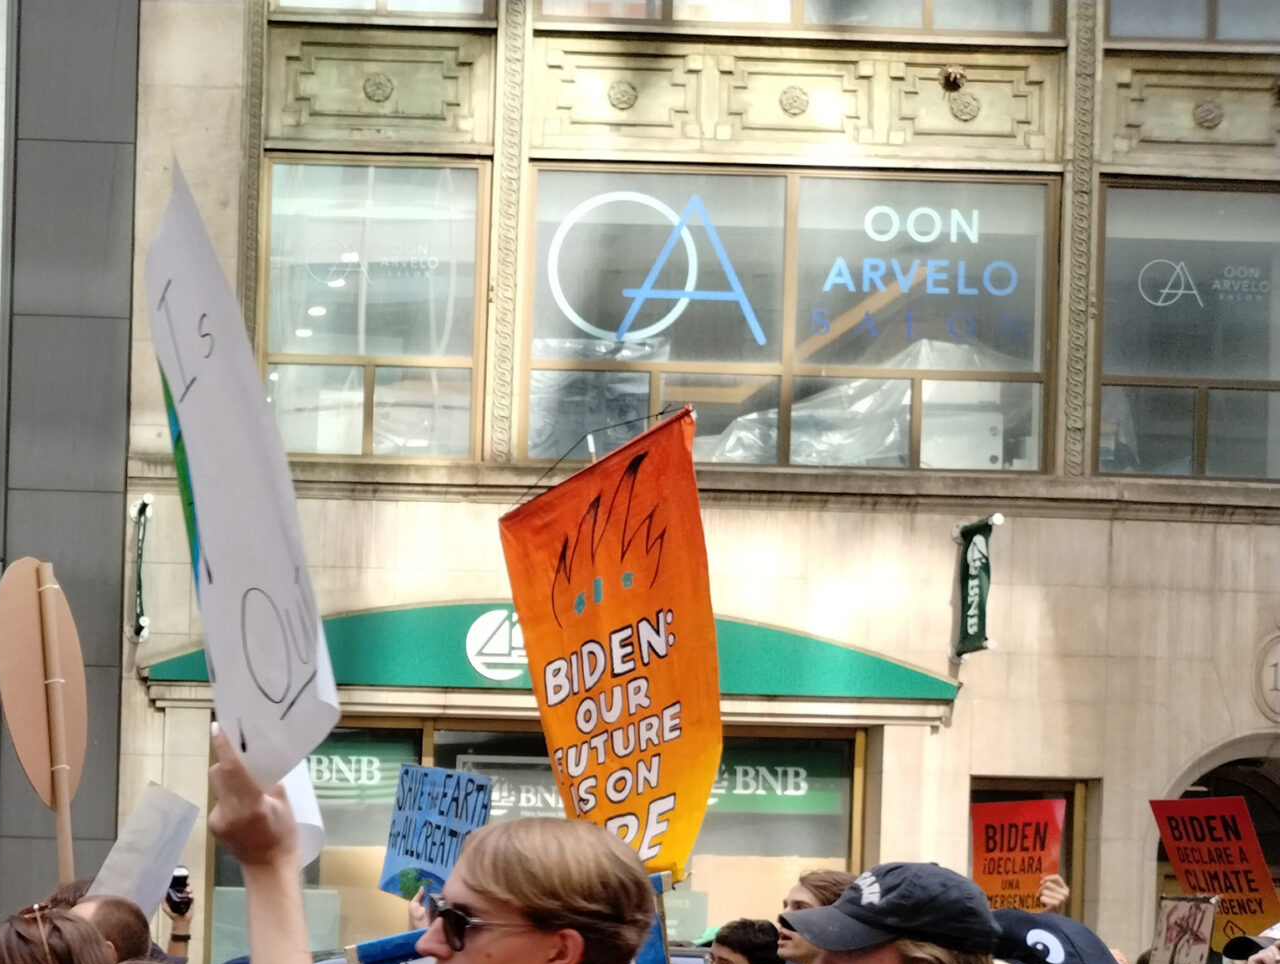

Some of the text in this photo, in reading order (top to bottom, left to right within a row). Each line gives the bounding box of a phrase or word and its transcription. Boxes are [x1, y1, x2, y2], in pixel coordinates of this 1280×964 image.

[863, 204, 980, 244] OON
[822, 255, 1019, 297] ARVELO
[1211, 279, 1271, 294] ARVELO
[543, 607, 677, 708] BIDEN:
[575, 675, 652, 735] OUR
[308, 754, 382, 785] BNB
[570, 753, 661, 818] IS ON
[732, 765, 809, 796] BNB
[396, 768, 429, 812] SAVE
[437, 772, 489, 829] EARTH
[984, 820, 1049, 854] BIDEN
[1166, 813, 1243, 843] BIDEN
[1175, 845, 1249, 865] DECLARE A
[1000, 878, 1021, 891] UNA
[1183, 868, 1259, 894] CLIMATE
